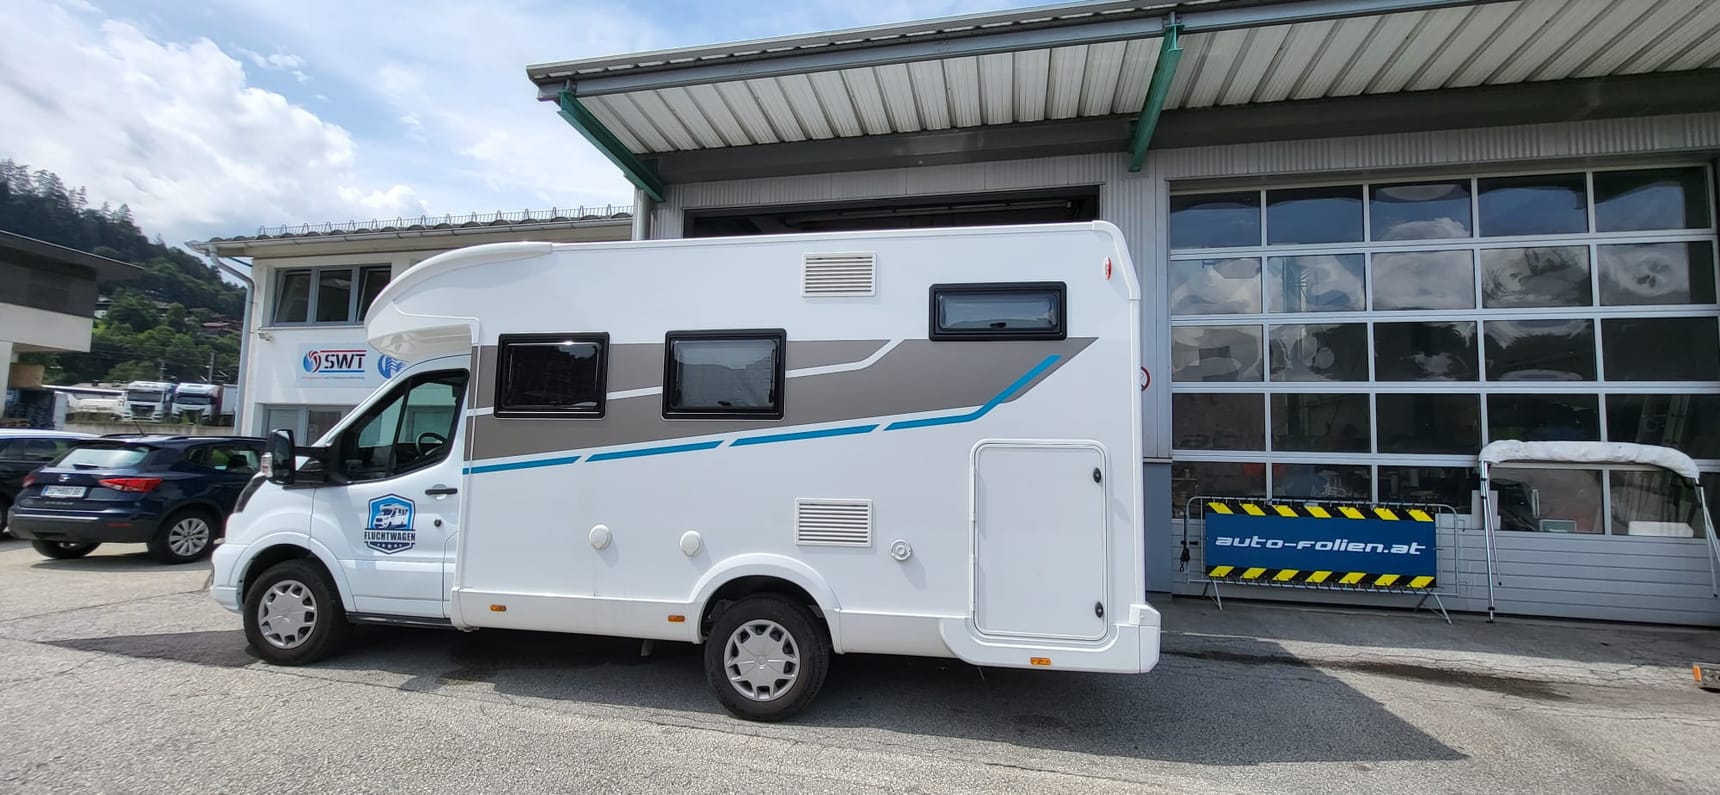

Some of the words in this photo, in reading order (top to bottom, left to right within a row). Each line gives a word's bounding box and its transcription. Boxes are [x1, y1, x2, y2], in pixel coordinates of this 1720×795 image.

[324, 354, 366, 369] SWT
[364, 531, 416, 541] FLUCHTWAGEN
[1215, 535, 1426, 555] auto-folien.at
